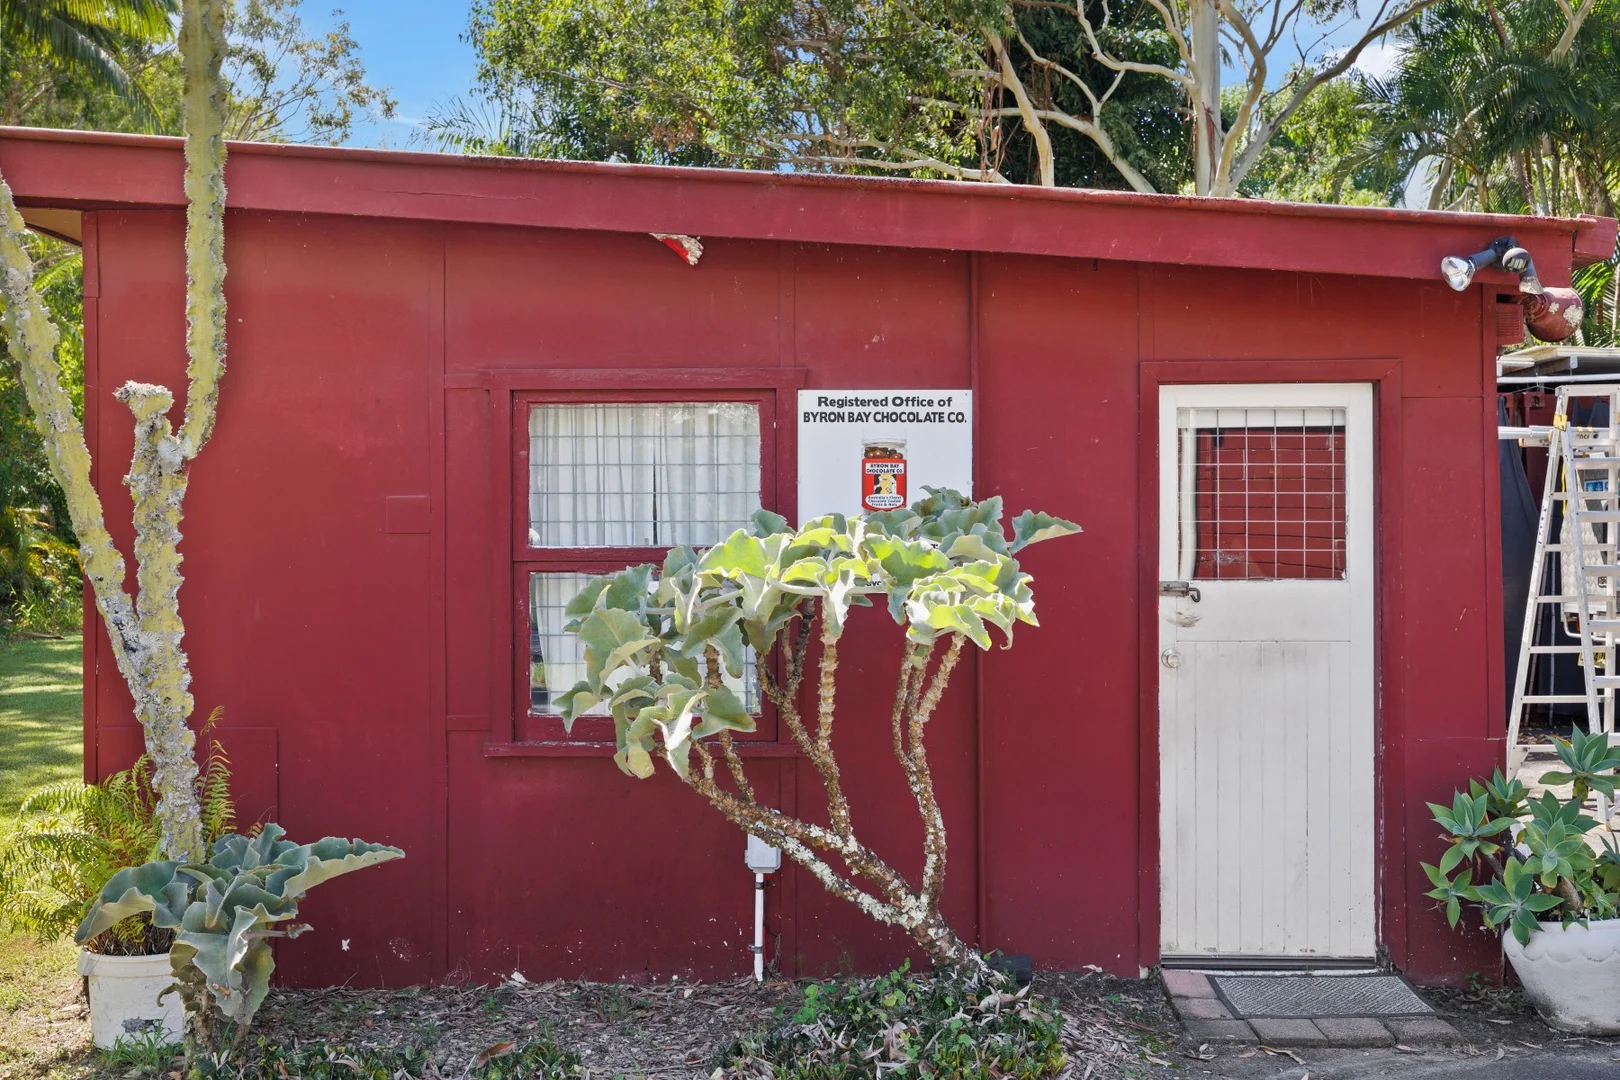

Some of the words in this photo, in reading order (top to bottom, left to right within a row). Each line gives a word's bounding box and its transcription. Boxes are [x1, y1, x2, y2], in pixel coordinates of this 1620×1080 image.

[817, 396, 889, 409] Registered
[891, 396, 934, 408] Office
[937, 396, 953, 408] of
[803, 411, 846, 423] BYRON
[847, 411, 872, 423] BAY
[872, 411, 945, 423] CHOCOLATE
[947, 411, 967, 423] CO.
